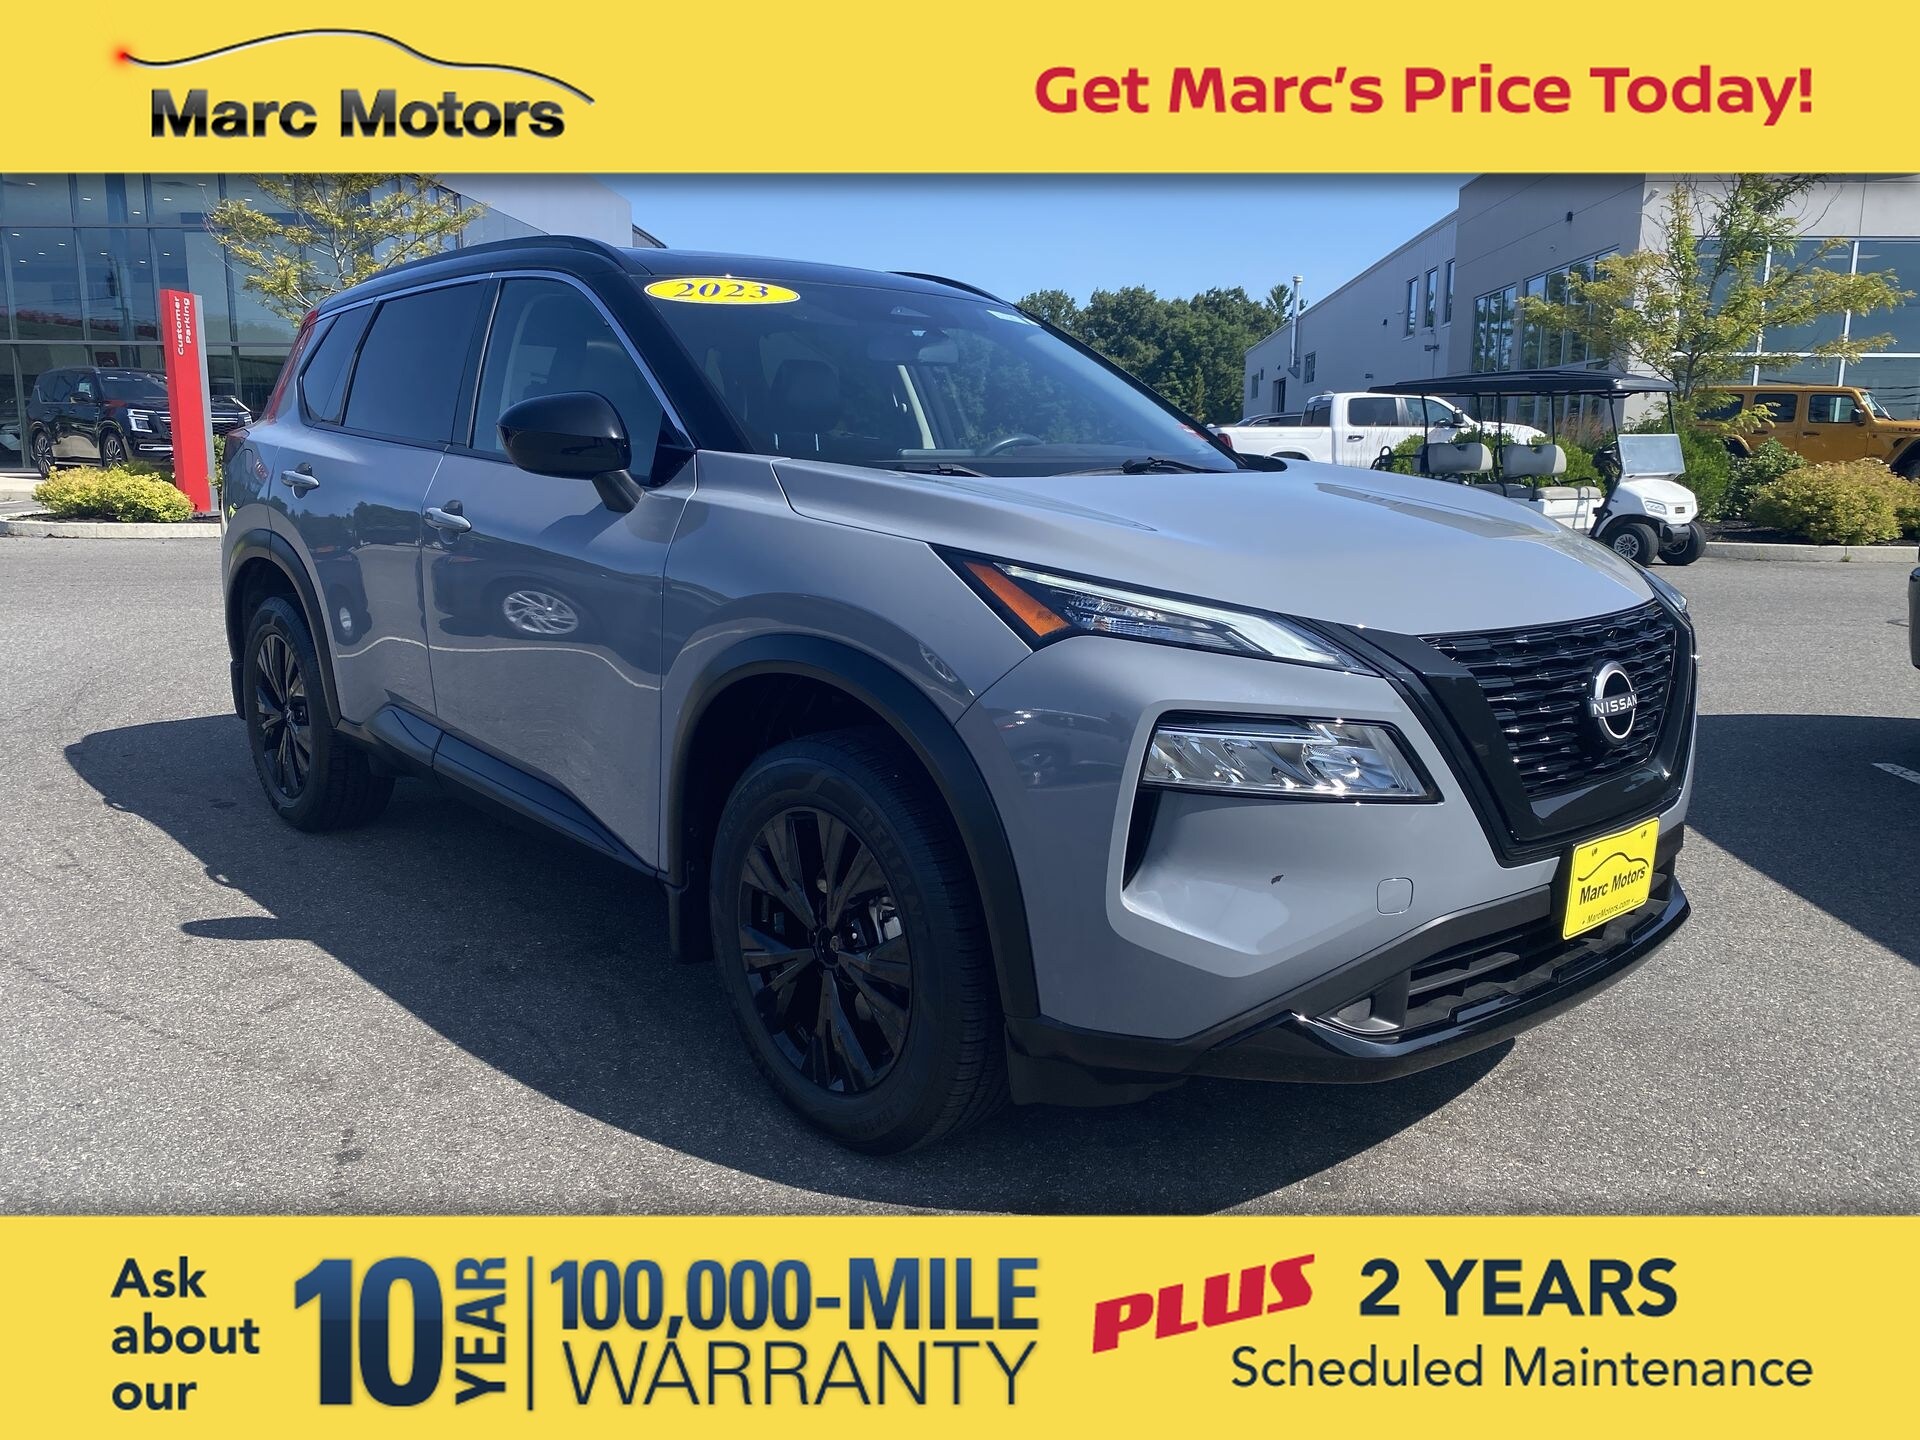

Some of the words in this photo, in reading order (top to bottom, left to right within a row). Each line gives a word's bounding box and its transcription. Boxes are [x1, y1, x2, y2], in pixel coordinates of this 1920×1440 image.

[674, 282, 769, 298] 2023
[174, 296, 184, 355] Customer
[183, 297, 192, 344] Parking
[1593, 694, 1638, 715] NISSAN
[1579, 883, 1609, 906] Marc
[1611, 866, 1646, 893] Motors
